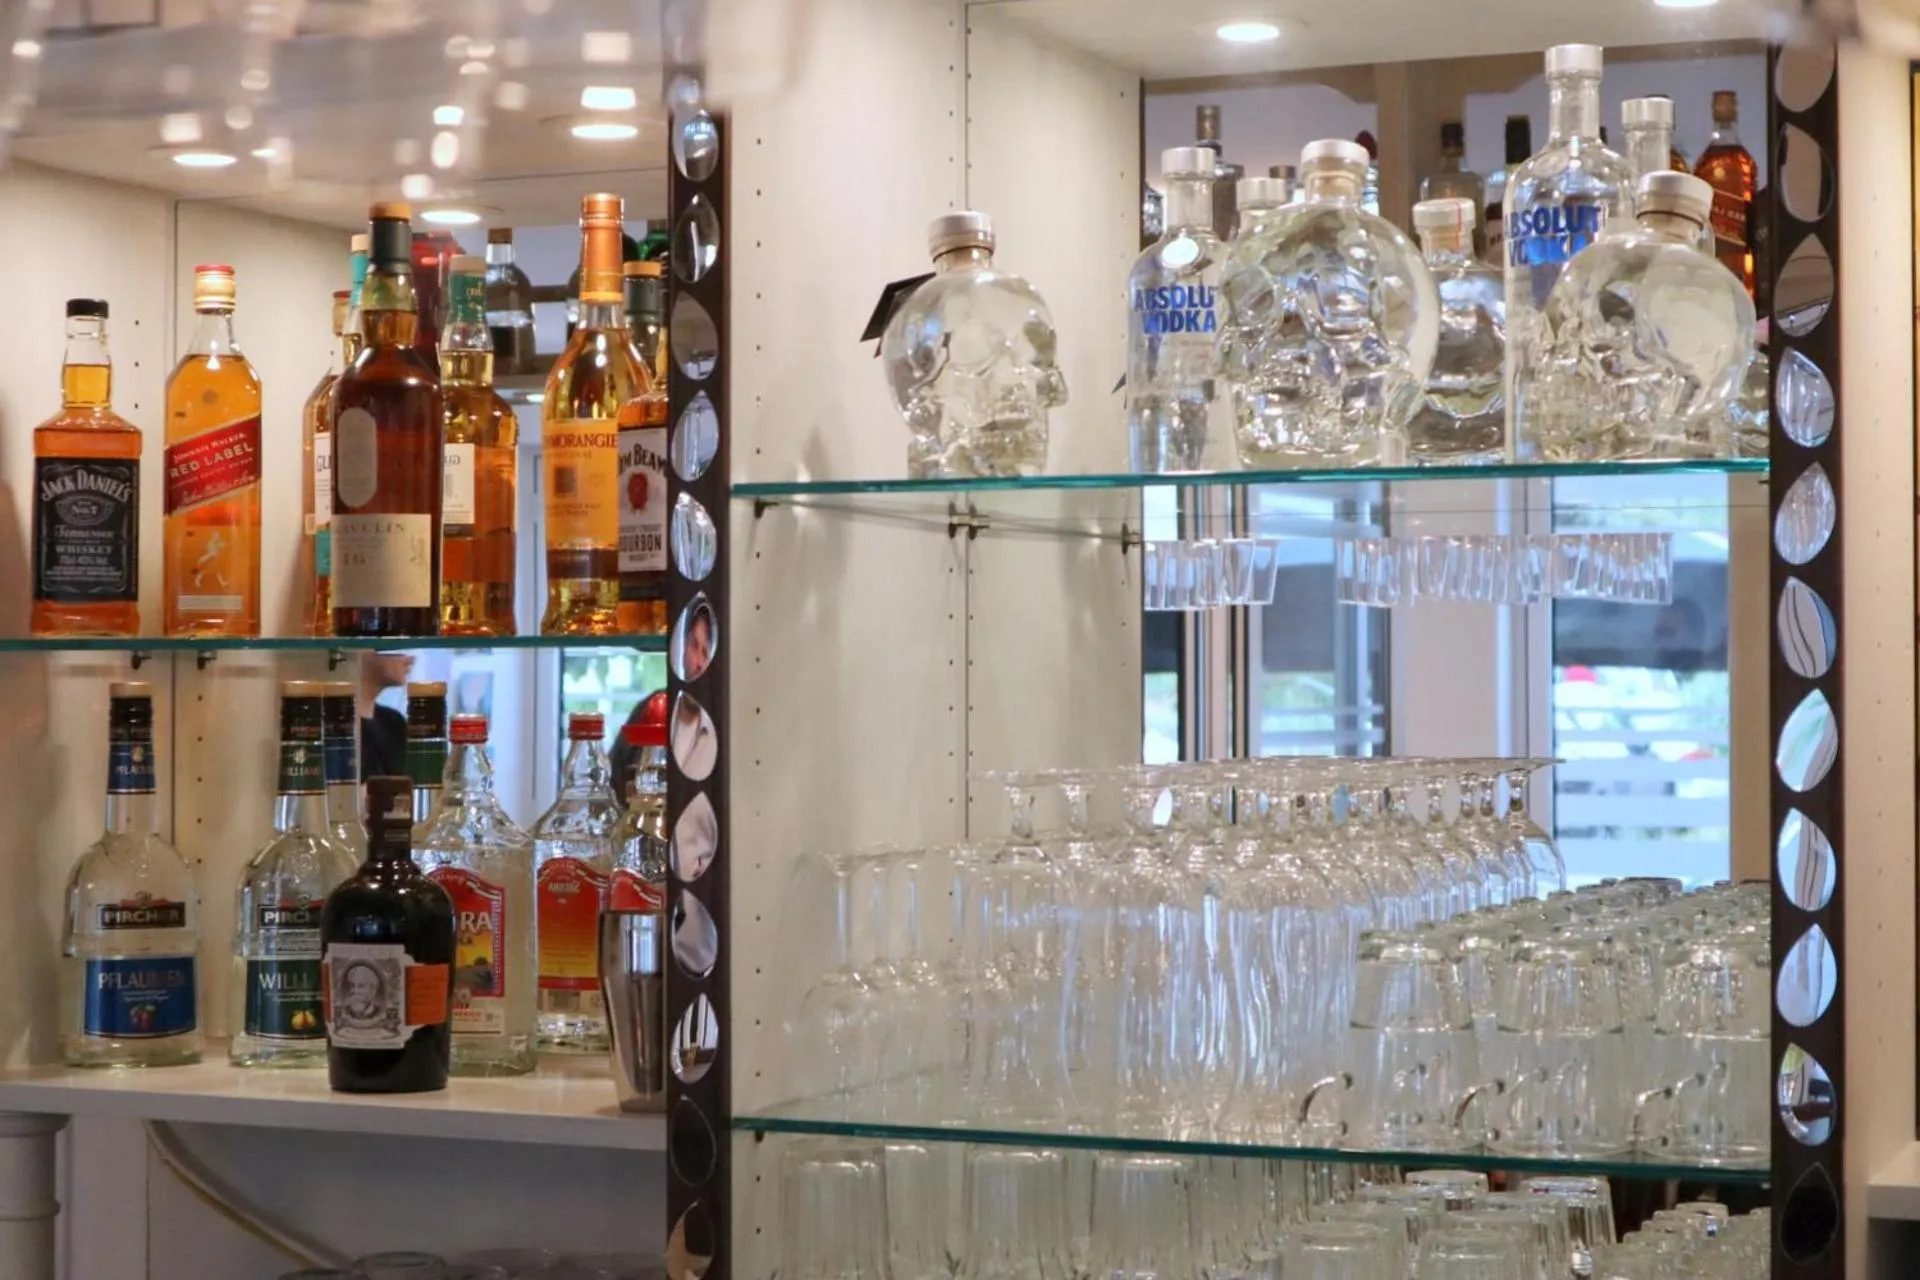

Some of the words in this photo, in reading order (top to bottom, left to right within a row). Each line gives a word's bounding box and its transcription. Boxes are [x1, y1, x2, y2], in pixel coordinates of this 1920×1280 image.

[1143, 310, 1217, 334] VODKA
[170, 460, 200, 478] RED
[203, 442, 254, 466] LABEL
[41, 475, 76, 501] JACK
[77, 469, 132, 503] DANIEL'S
